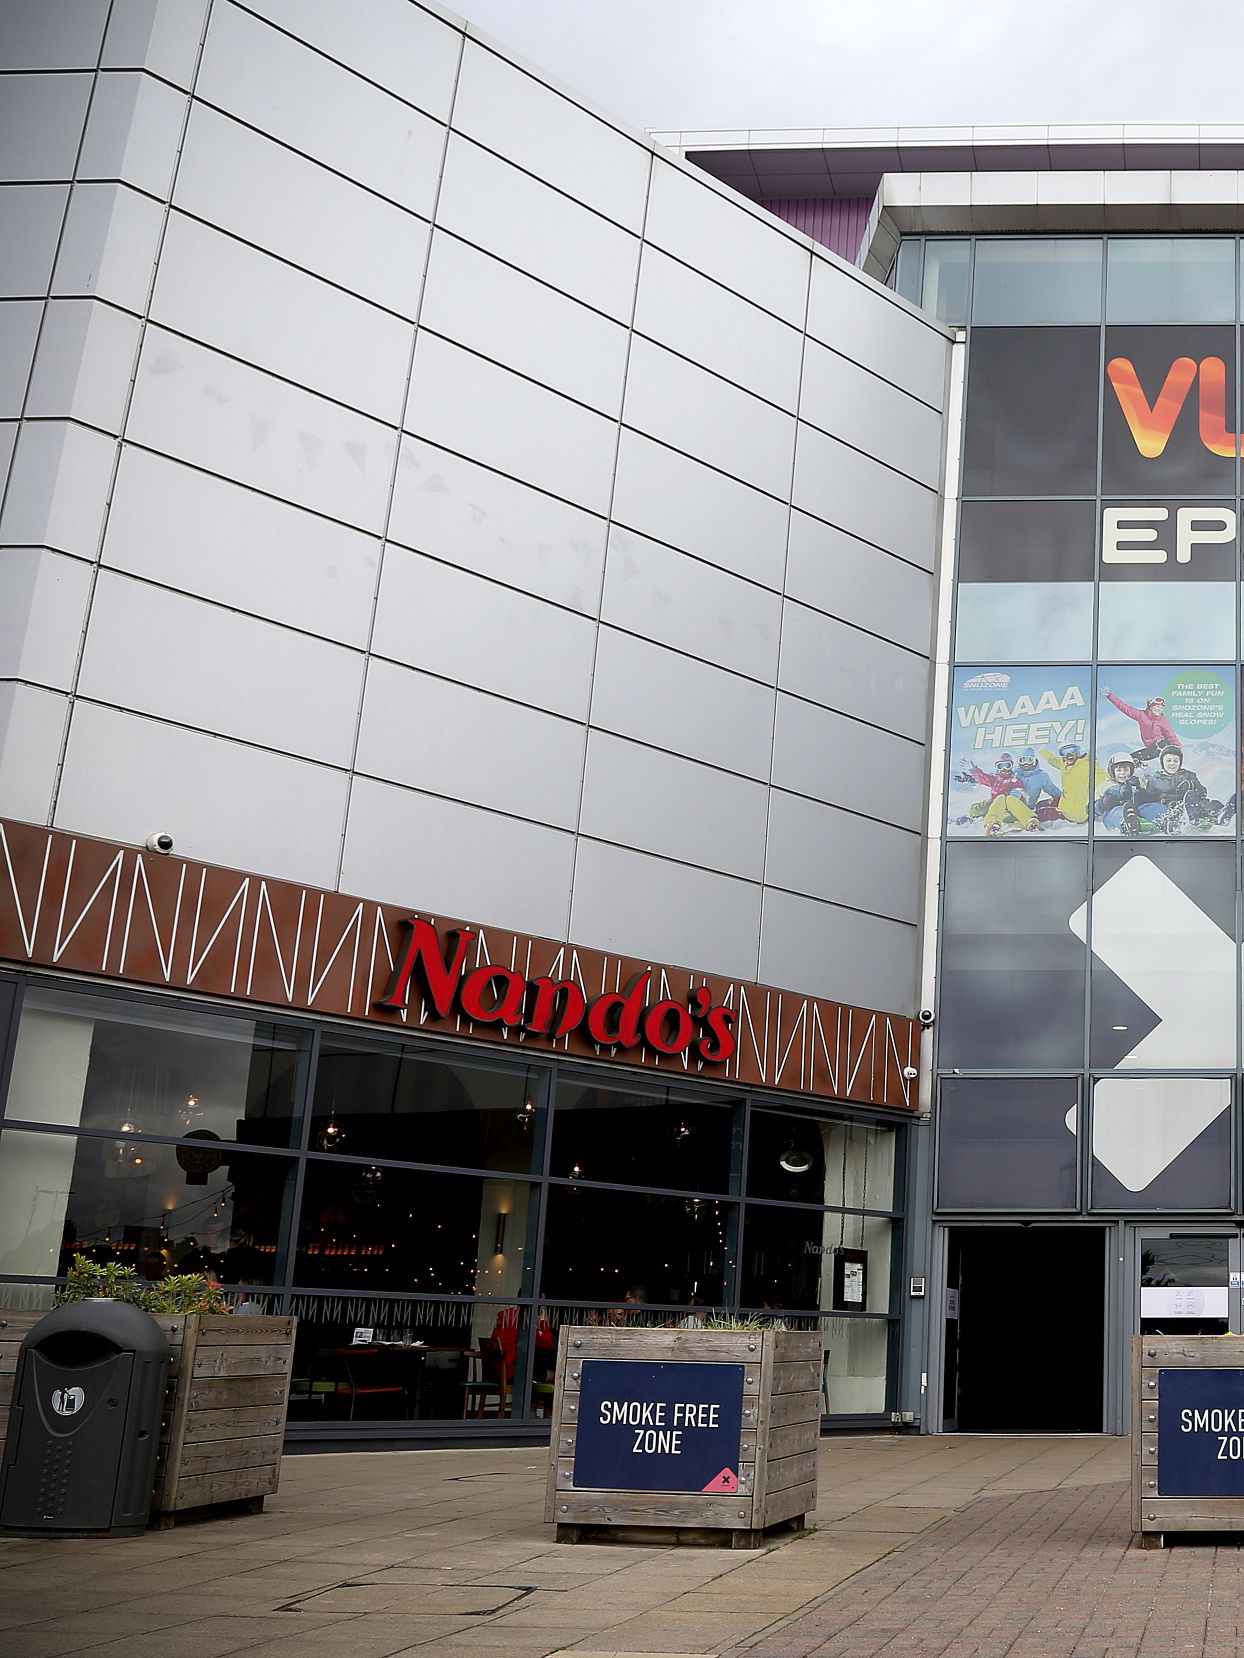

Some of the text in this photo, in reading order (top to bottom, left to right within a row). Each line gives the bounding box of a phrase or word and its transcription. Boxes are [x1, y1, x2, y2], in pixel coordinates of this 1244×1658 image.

[956, 685, 1086, 728] WAAAA
[974, 719, 1086, 749] HEEY!
[380, 917, 739, 1062] Nando's
[599, 1400, 720, 1428] SMOKE FREE
[632, 1429, 683, 1454] ZONE
